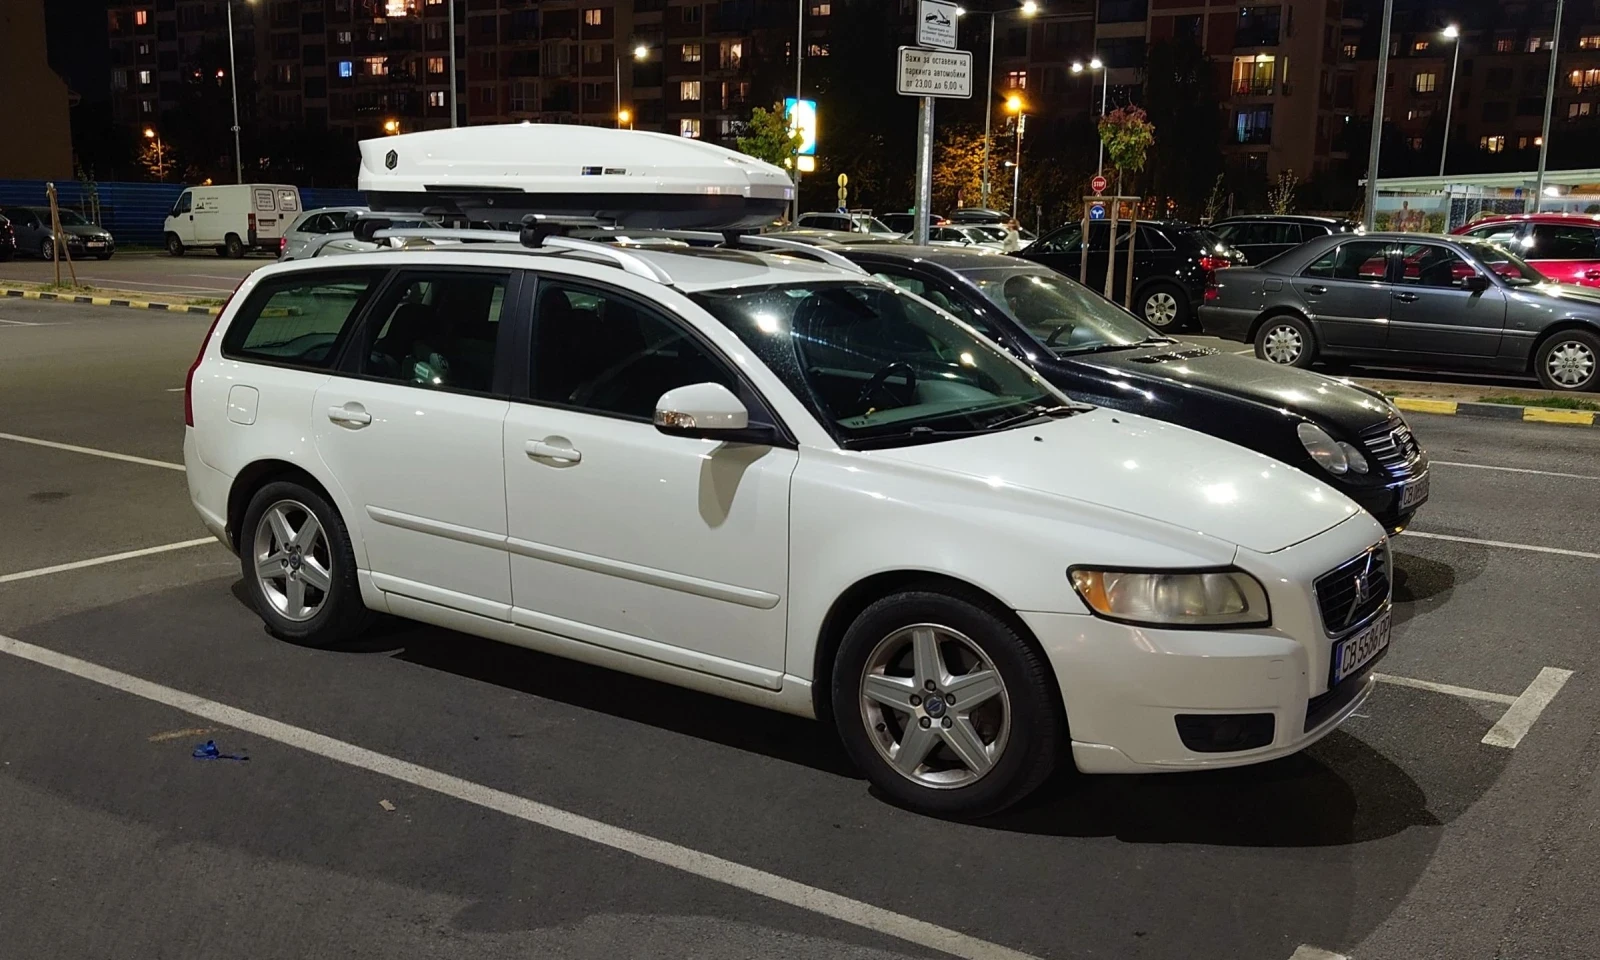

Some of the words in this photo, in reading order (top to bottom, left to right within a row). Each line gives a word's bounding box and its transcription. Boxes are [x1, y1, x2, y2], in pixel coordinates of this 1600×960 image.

[905, 53, 920, 62] Важи
[932, 57, 957, 66] оставени
[906, 68, 931, 77] паркинга
[934, 68, 966, 78] автомобили
[1342, 641, 1356, 673] CB
